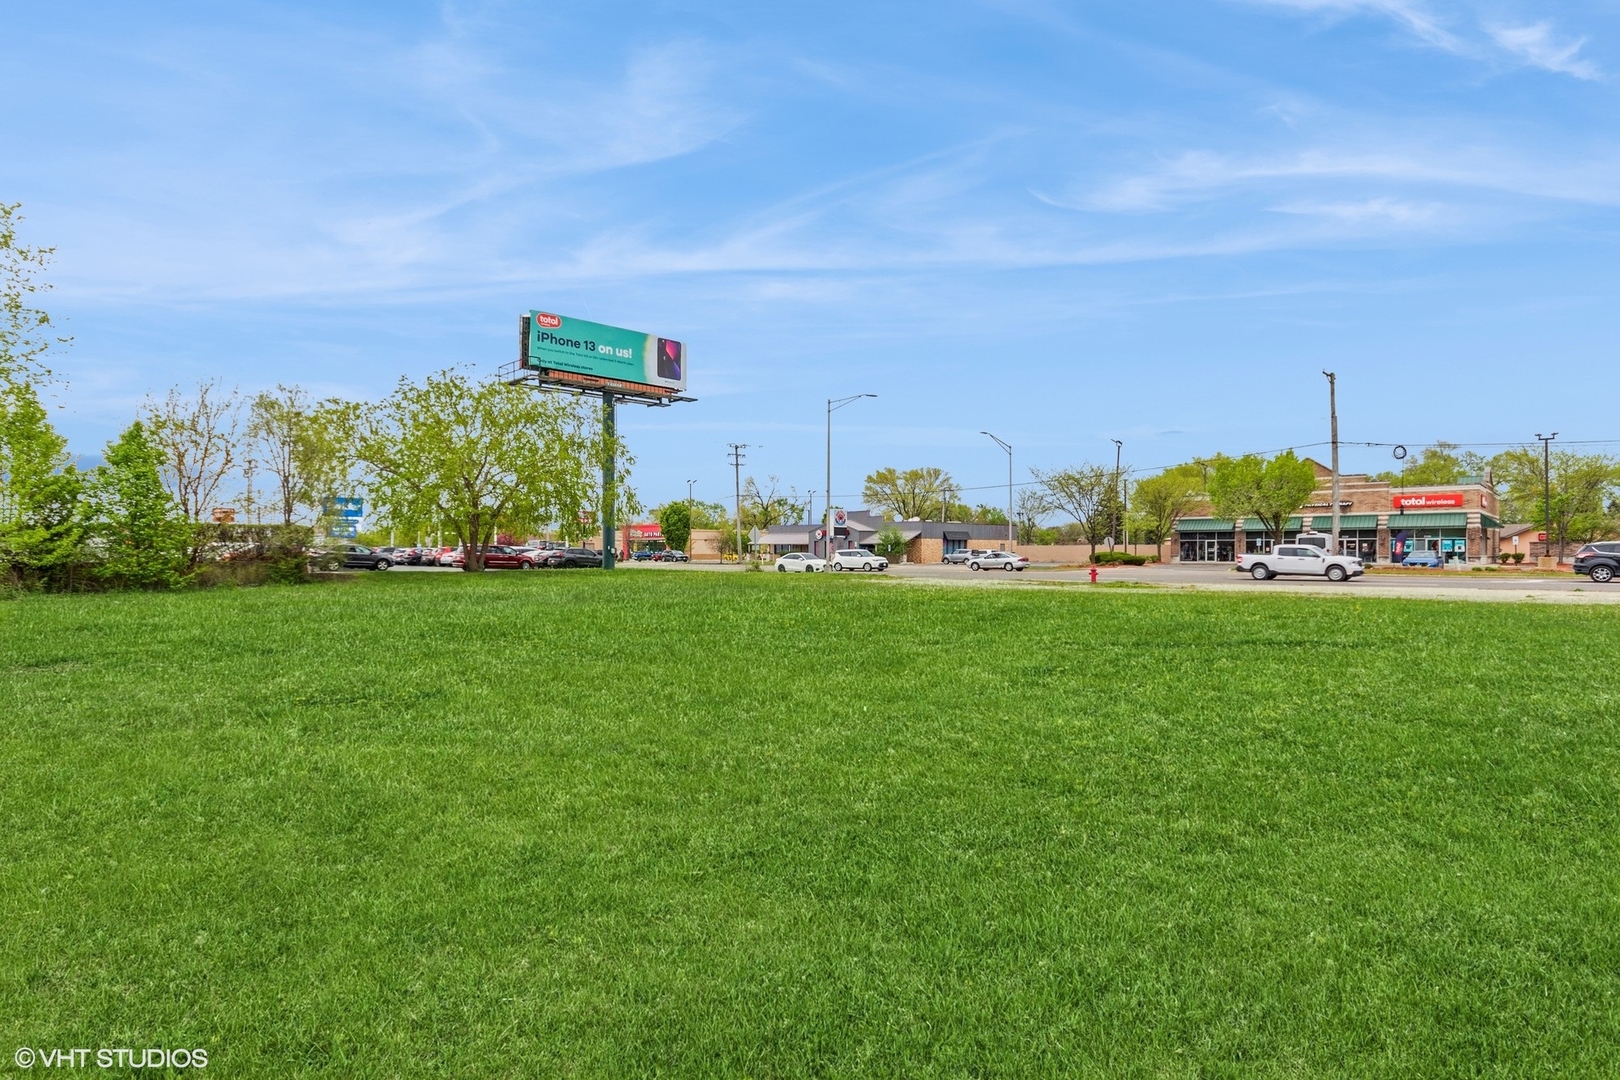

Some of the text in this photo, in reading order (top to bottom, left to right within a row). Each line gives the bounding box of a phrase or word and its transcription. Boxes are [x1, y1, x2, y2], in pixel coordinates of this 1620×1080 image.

[539, 315, 558, 326] total
[537, 330, 633, 359] iPhone 13 on us!
[1400, 496, 1426, 506] total
